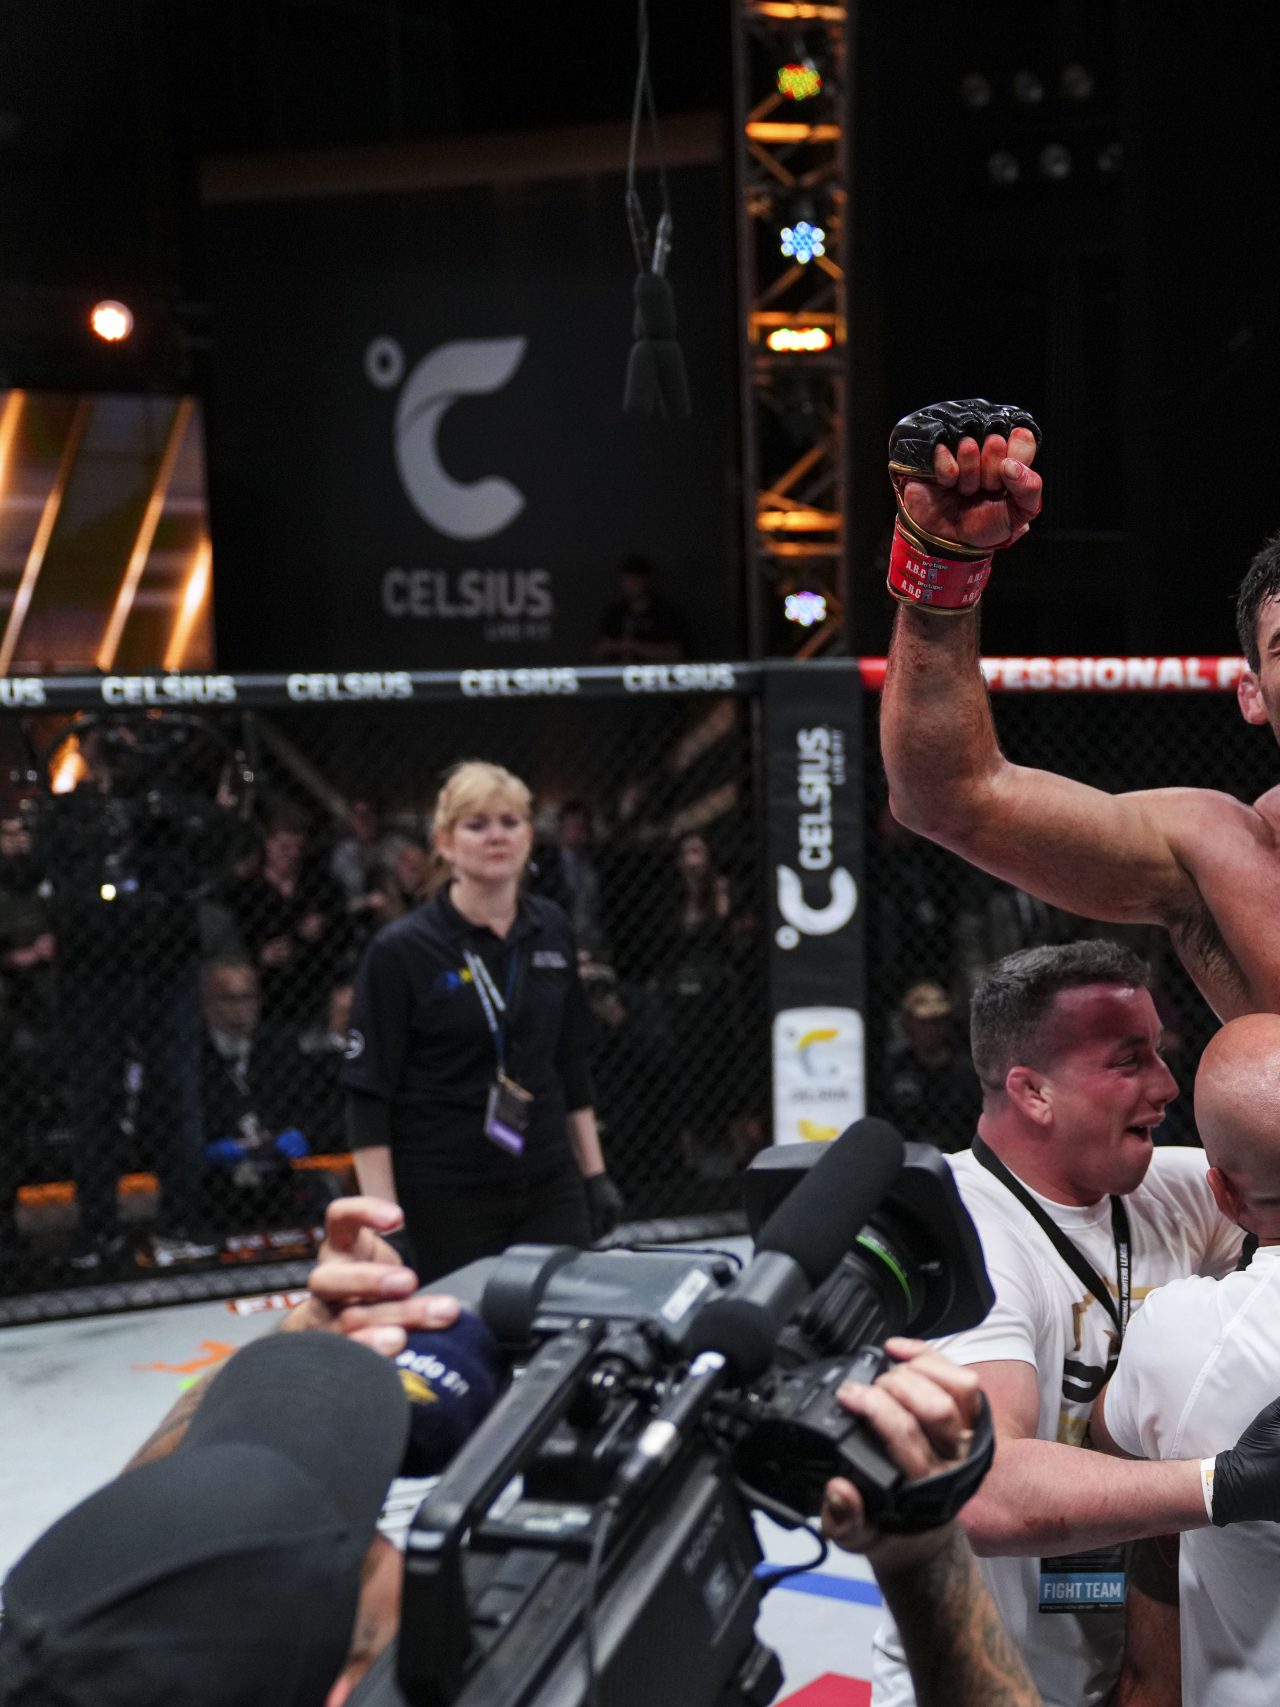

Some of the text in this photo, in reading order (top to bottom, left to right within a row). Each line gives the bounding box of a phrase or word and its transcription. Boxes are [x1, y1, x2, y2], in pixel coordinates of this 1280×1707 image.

[383, 568, 552, 618] CELSIUS
[0, 663, 736, 706] US CELSIUS CELSIUS CELSIUS CELSIUS
[980, 656, 1211, 690] FESSIONAL
[797, 726, 833, 871] CELSIUS
[1043, 1582, 1121, 1599] FIGHT TEAM
